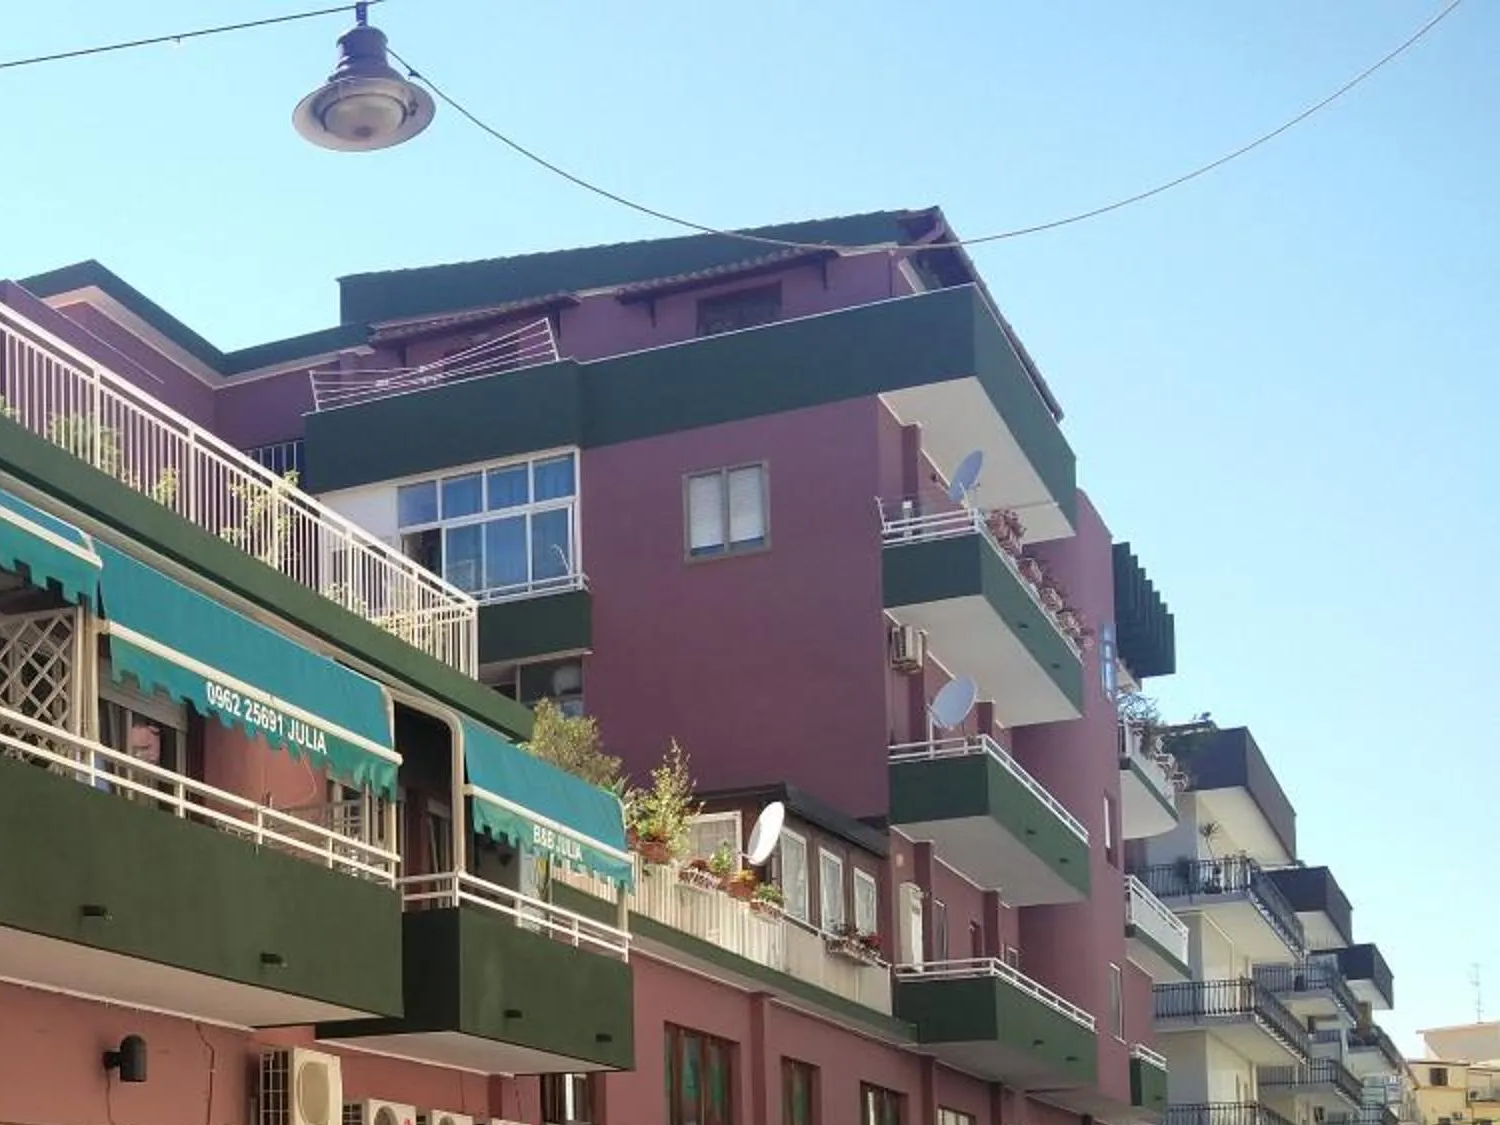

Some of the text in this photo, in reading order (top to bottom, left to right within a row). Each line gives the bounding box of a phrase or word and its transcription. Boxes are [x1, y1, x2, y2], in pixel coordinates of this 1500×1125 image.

[206, 681, 328, 756] 0962 25691 JULIA
[533, 824, 555, 849] B&B
